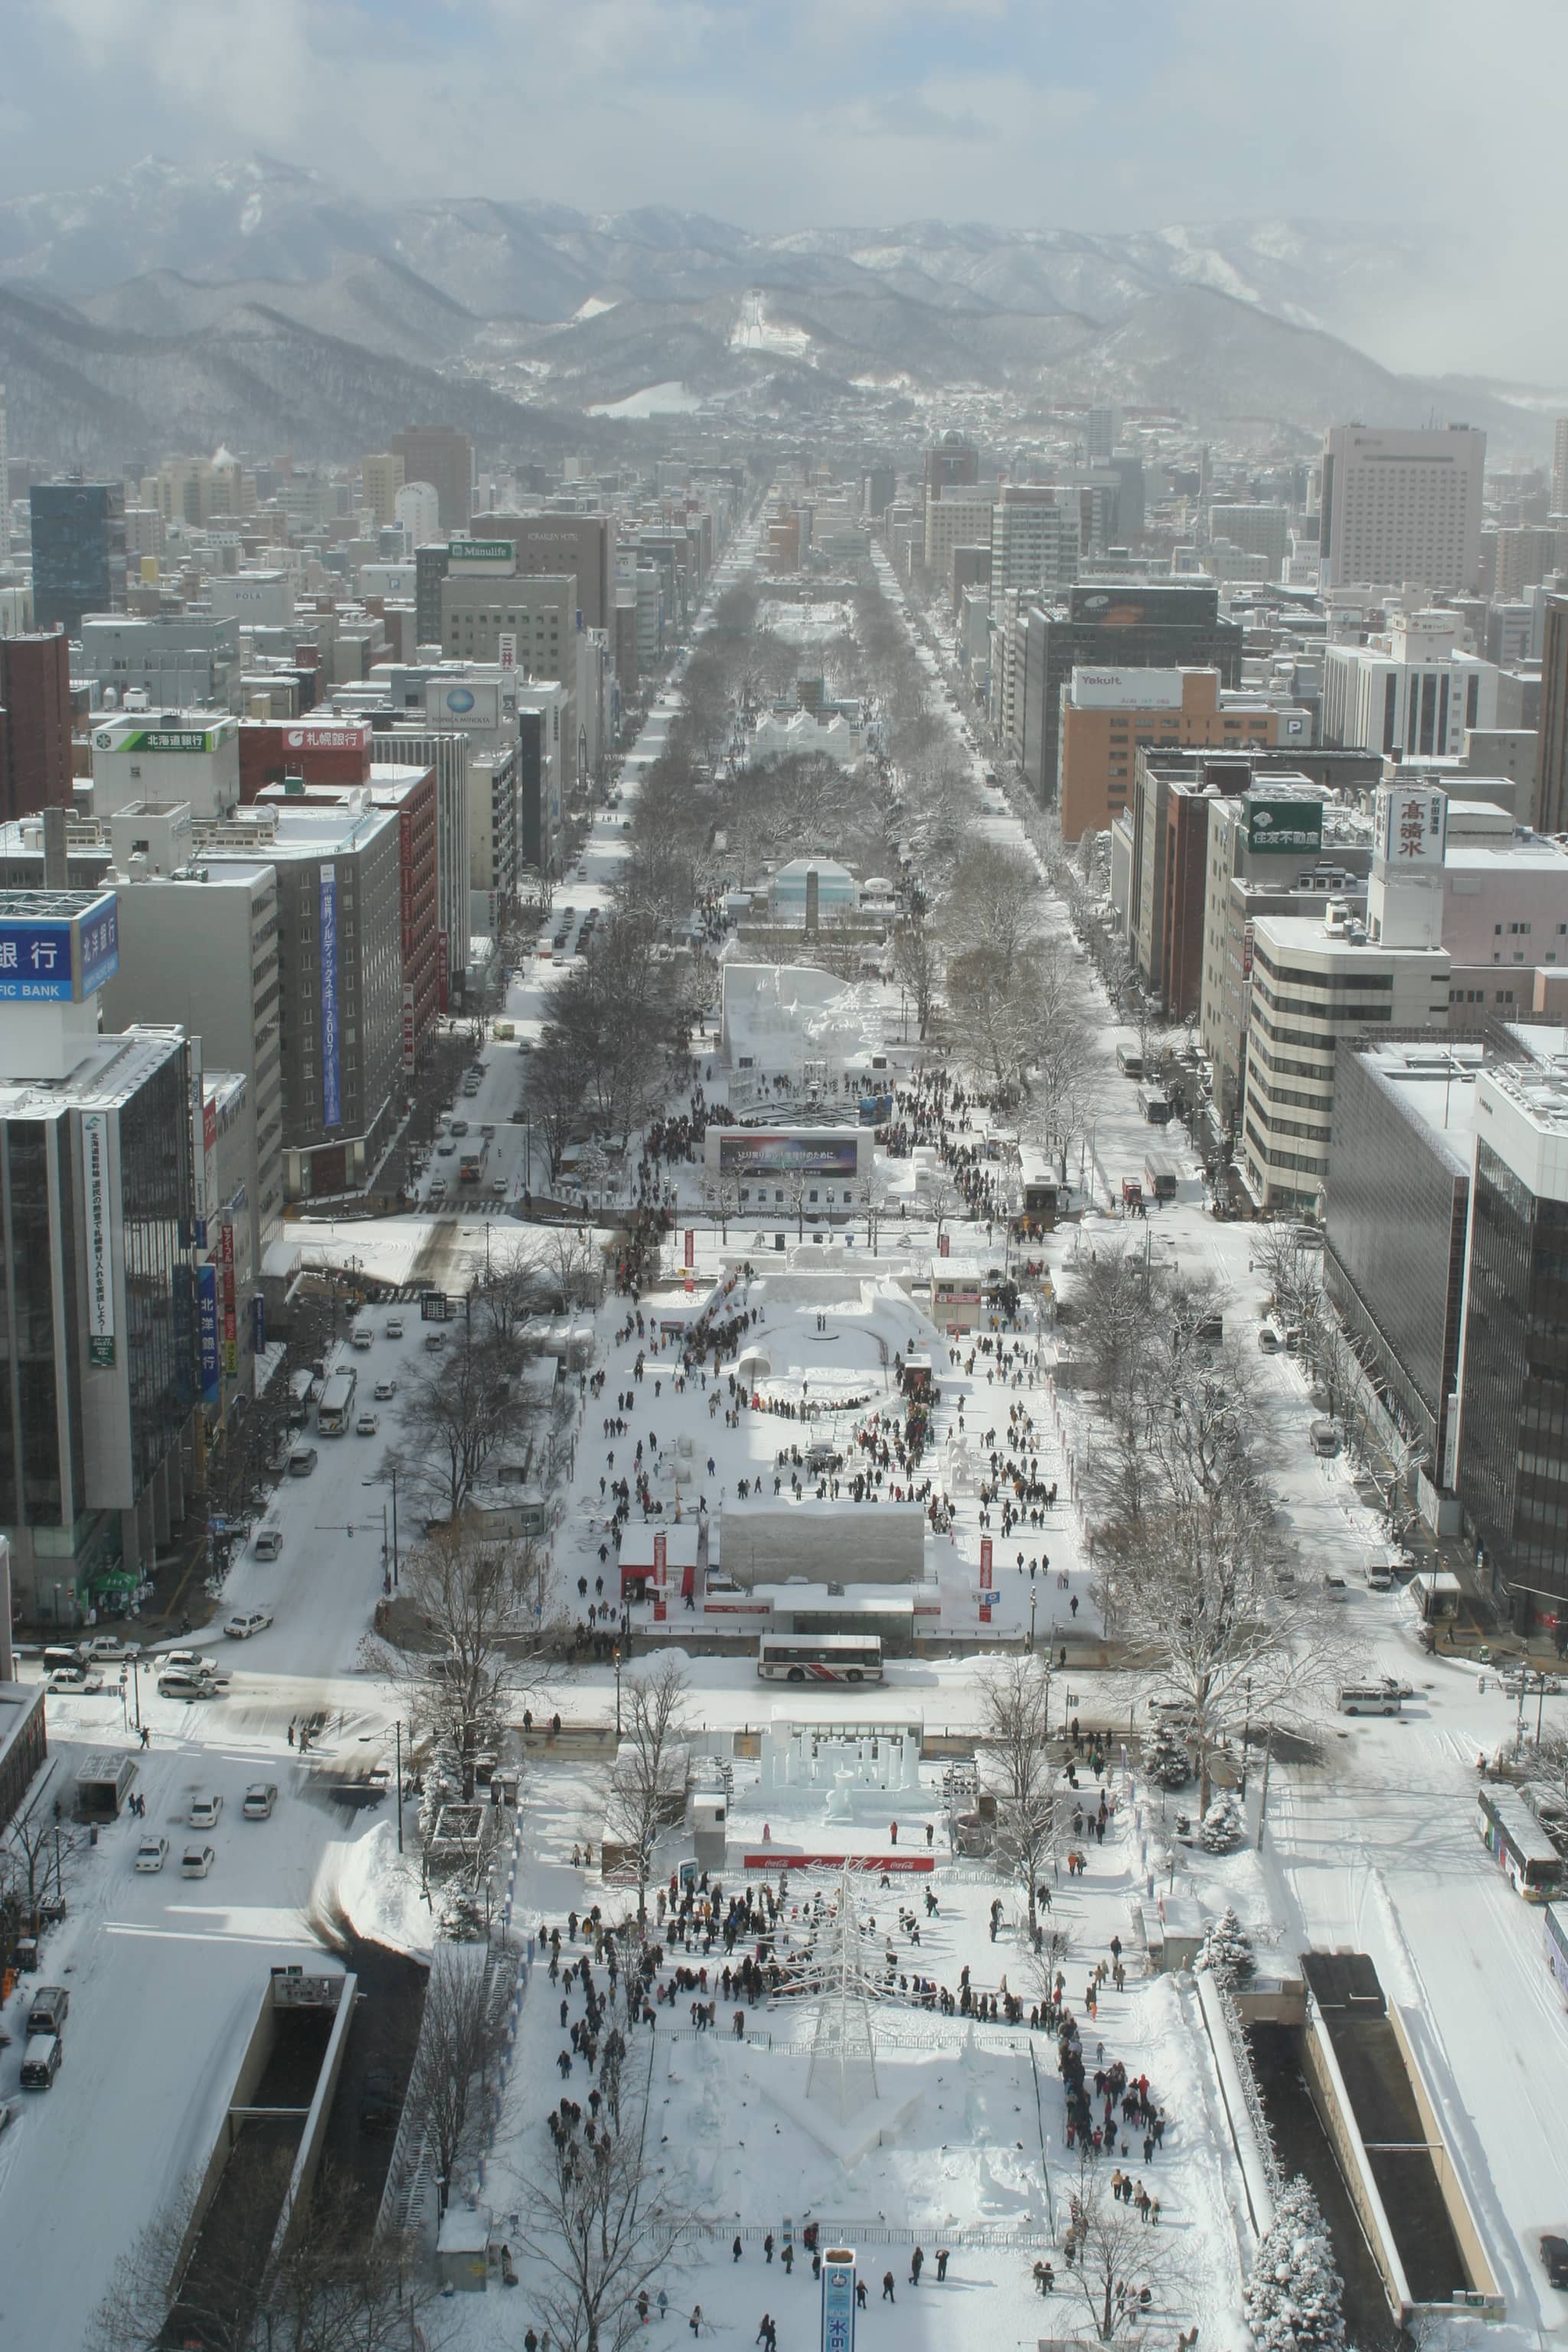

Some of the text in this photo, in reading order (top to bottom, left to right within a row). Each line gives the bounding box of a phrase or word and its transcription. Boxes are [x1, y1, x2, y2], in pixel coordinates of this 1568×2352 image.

[465, 546, 507, 557] Manulife
[501, 637, 513, 670] 三井
[1082, 676, 1122, 685] Yakult
[1289, 720, 1301, 733] P
[148, 733, 203, 746] 北海道銀行
[307, 731, 358, 747] 札幌銀行
[1253, 831, 1319, 844] 住友不動産
[22, 985, 60, 996] BANK
[201, 1298, 215, 1370] 北洋銀行
